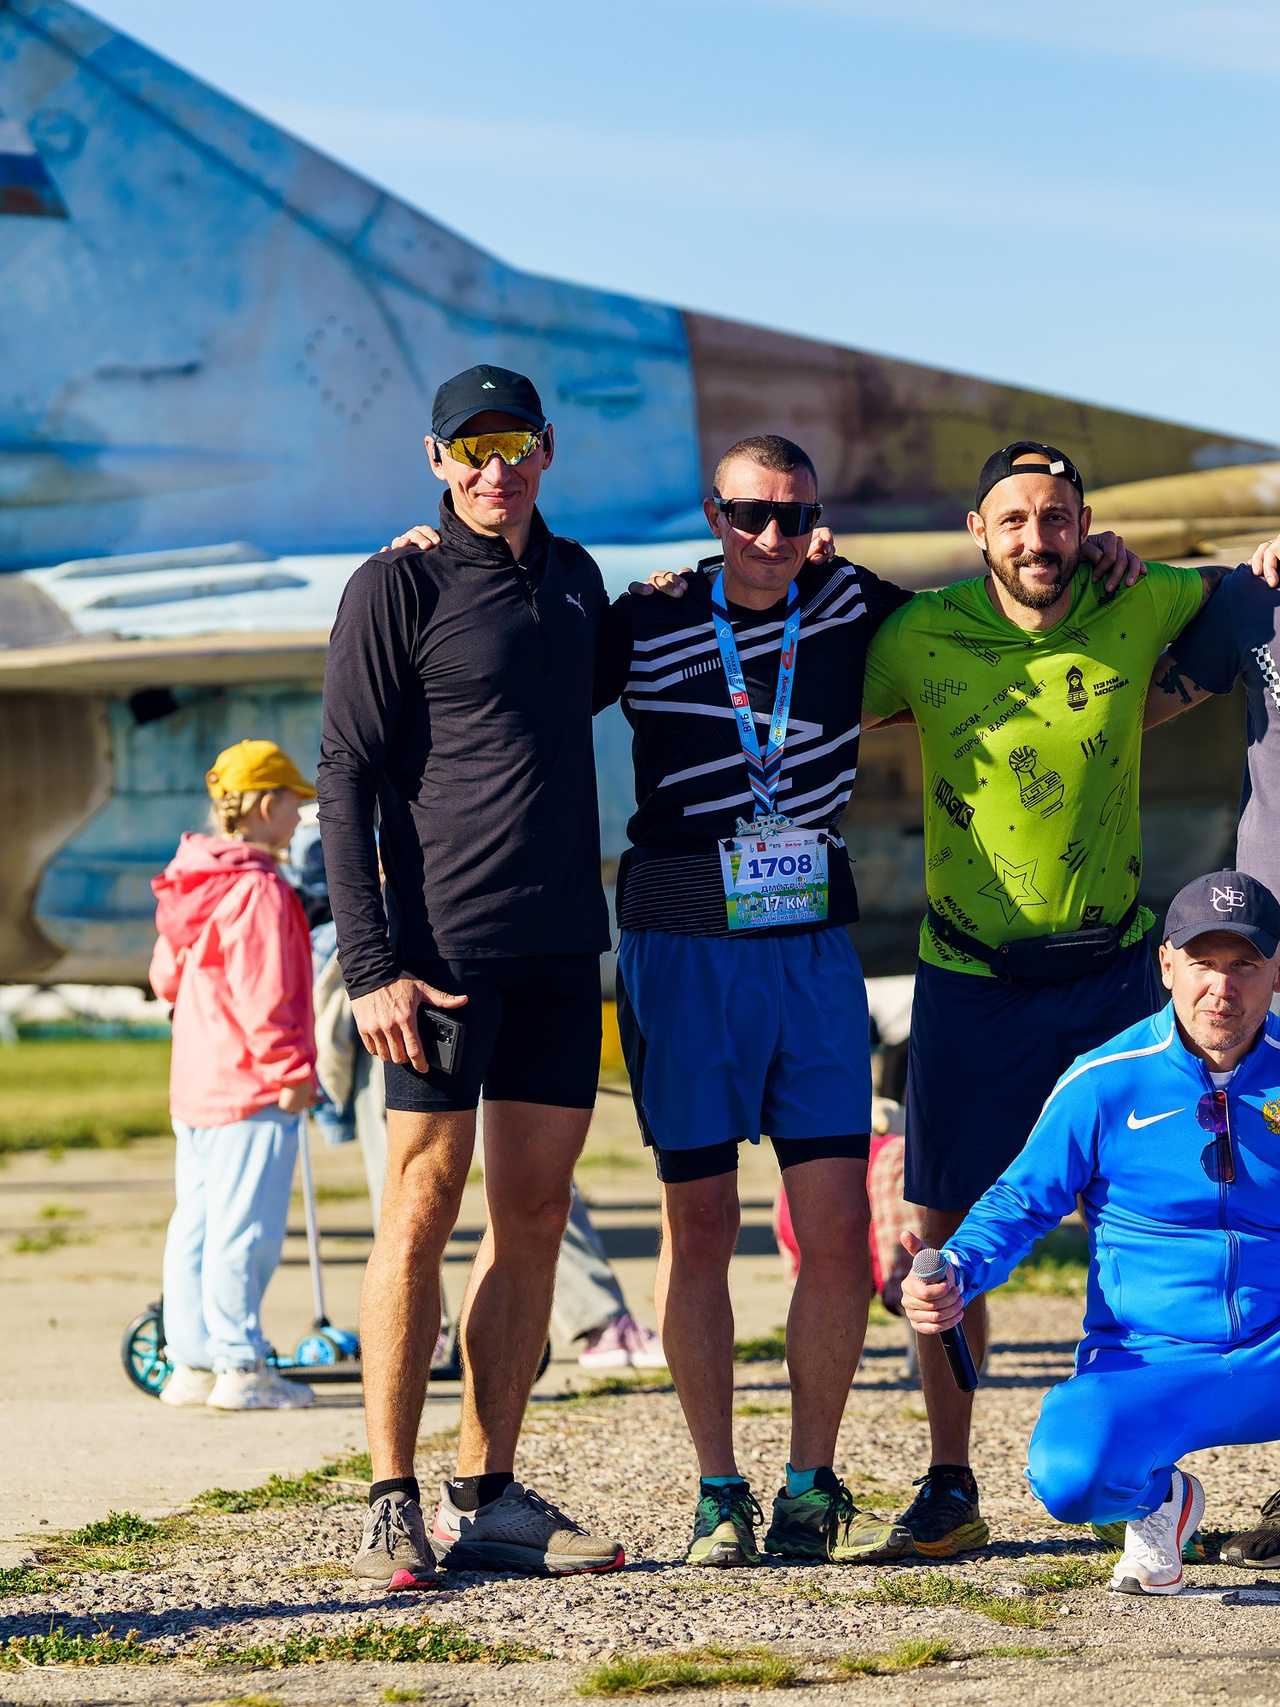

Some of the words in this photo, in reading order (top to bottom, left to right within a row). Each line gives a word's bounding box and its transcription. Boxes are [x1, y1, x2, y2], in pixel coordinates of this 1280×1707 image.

[729, 651, 738, 674] SERVICE
[1094, 679, 1129, 697] МОСКВА
[740, 713, 752, 733] ВТБ
[949, 713, 982, 738] МОСКВА
[953, 731, 988, 760] КОТОРЫЙ
[987, 679, 1047, 733] ВДОХНОВЛЯЕТ
[747, 853, 813, 880] 1708
[762, 896, 780, 912] 17
[786, 895, 807, 910] КМ
